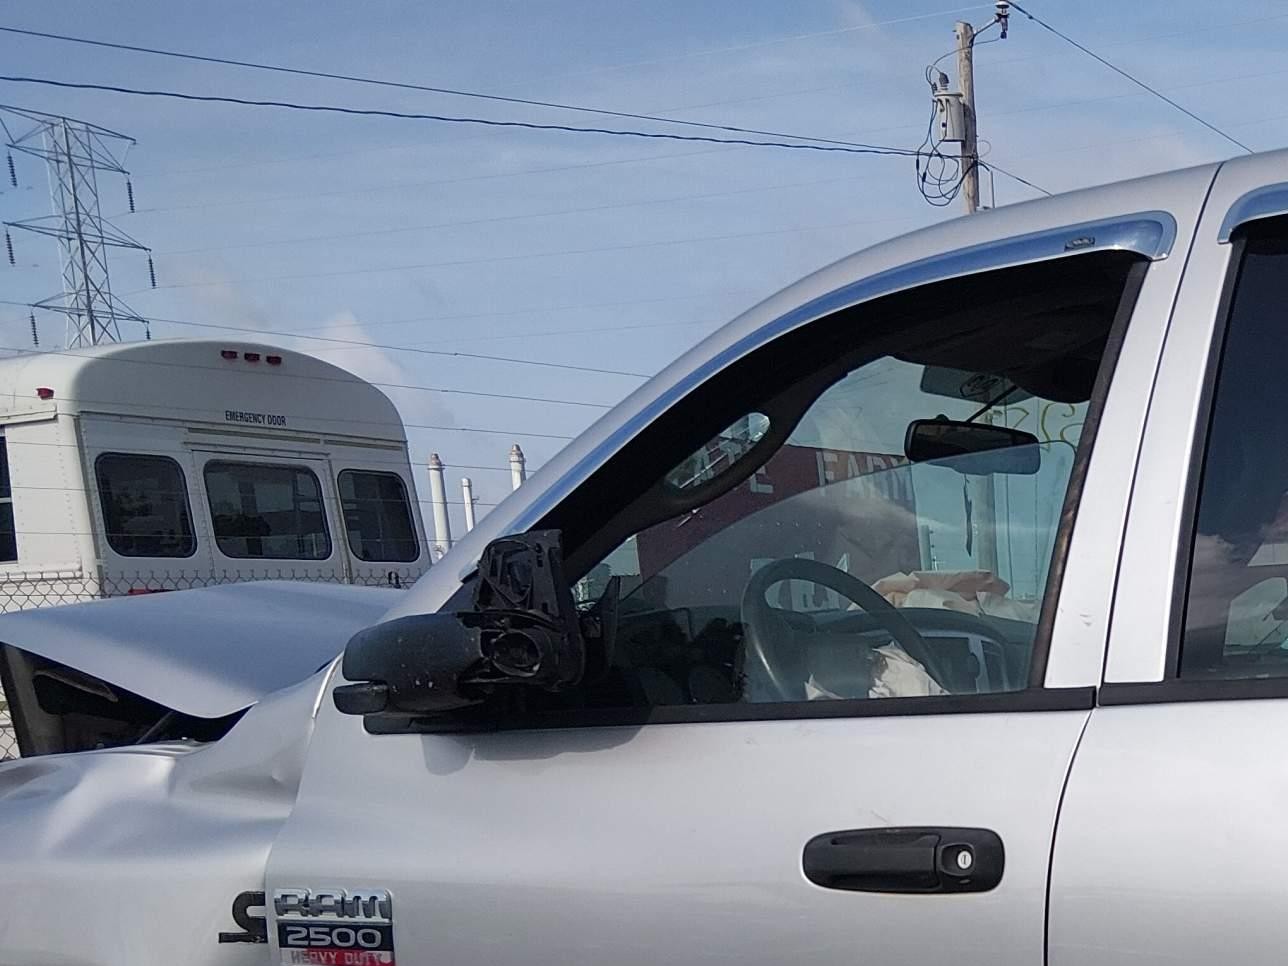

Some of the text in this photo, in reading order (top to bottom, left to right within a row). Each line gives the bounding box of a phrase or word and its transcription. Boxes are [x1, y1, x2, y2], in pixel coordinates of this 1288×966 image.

[225, 410, 287, 426] EMERGENCY DOOR
[286, 926, 383, 948] 2500
[290, 950, 382, 966] HEAVY DUTY
